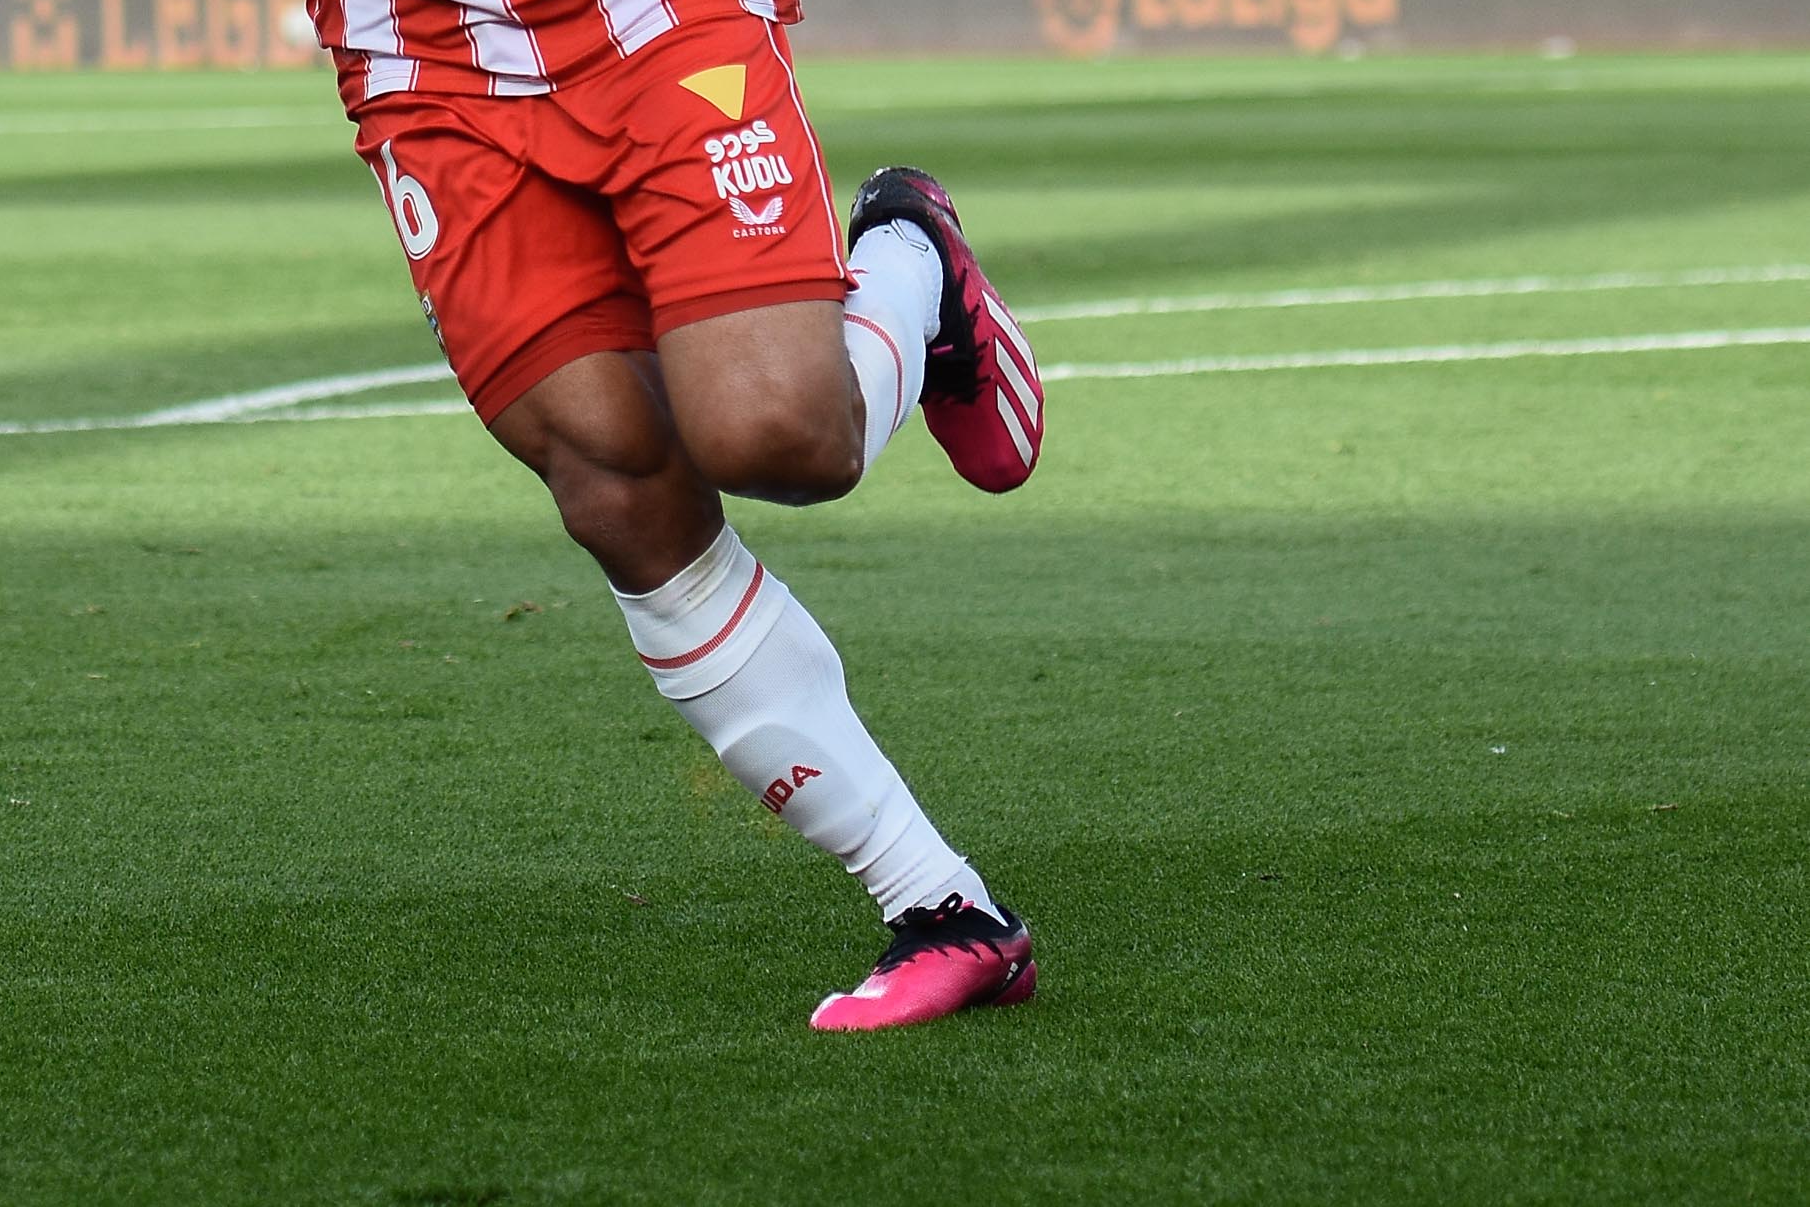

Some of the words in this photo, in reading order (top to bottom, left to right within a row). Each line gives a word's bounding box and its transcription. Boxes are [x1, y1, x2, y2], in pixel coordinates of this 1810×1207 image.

[704, 119, 777, 164] كودو
[711, 154, 793, 200] KUDU
[732, 225, 787, 239] CASTORE
